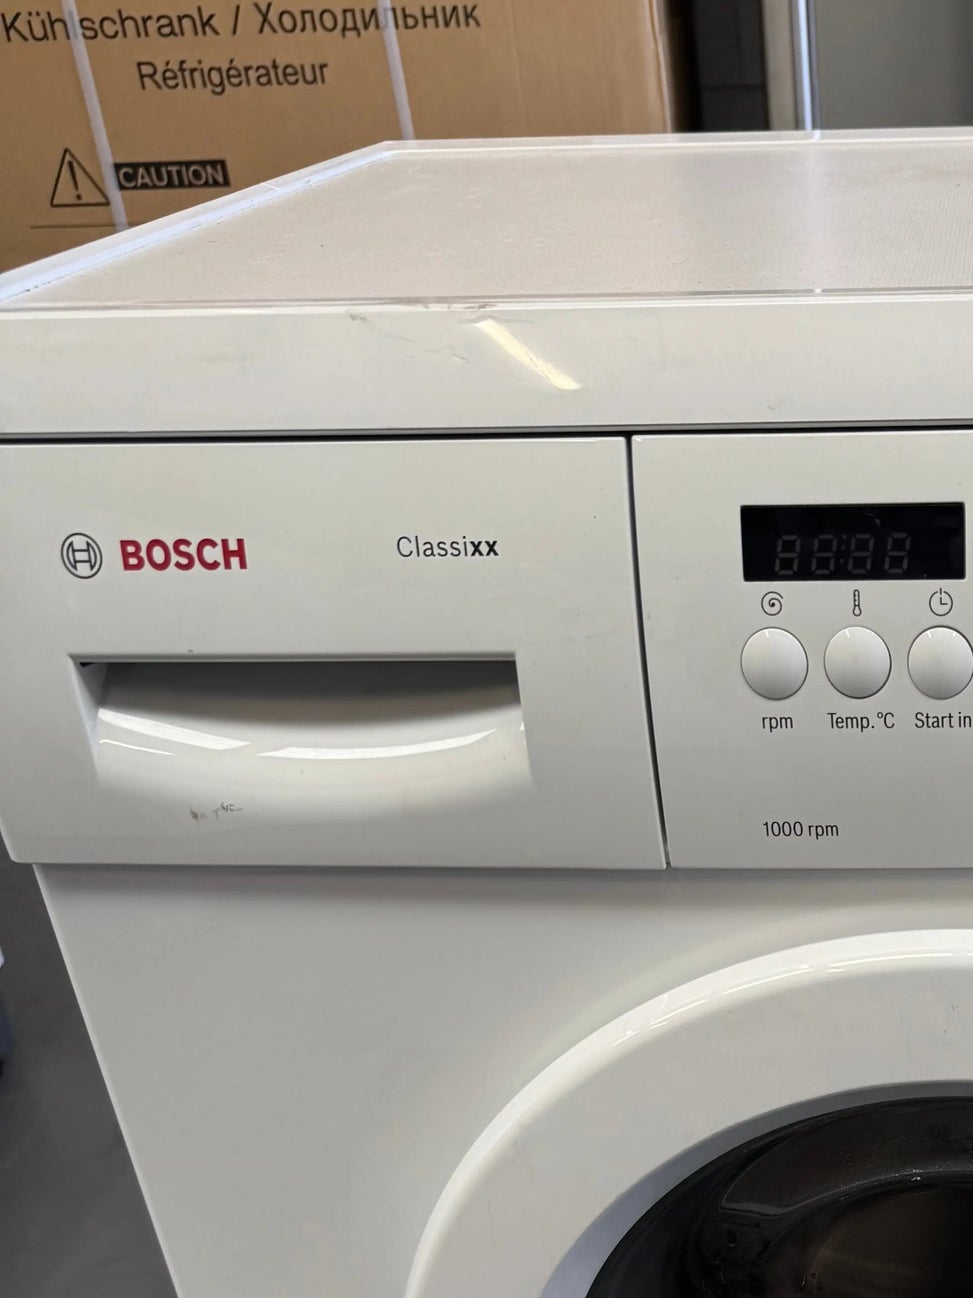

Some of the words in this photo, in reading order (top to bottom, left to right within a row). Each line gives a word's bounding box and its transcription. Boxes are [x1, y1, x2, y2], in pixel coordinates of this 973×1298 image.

[253, 1, 481, 39] Холодильник
[136, 58, 328, 96] Réfrigérateur
[118, 163, 226, 188] CAUTION
[119, 537, 248, 572] BOSCH
[396, 534, 500, 558] Classixx
[762, 716, 794, 733] rpm
[914, 712, 954, 729] Start
[957, 711, 973, 729] in
[762, 820, 804, 837] 1000
[807, 824, 839, 841] rpm
